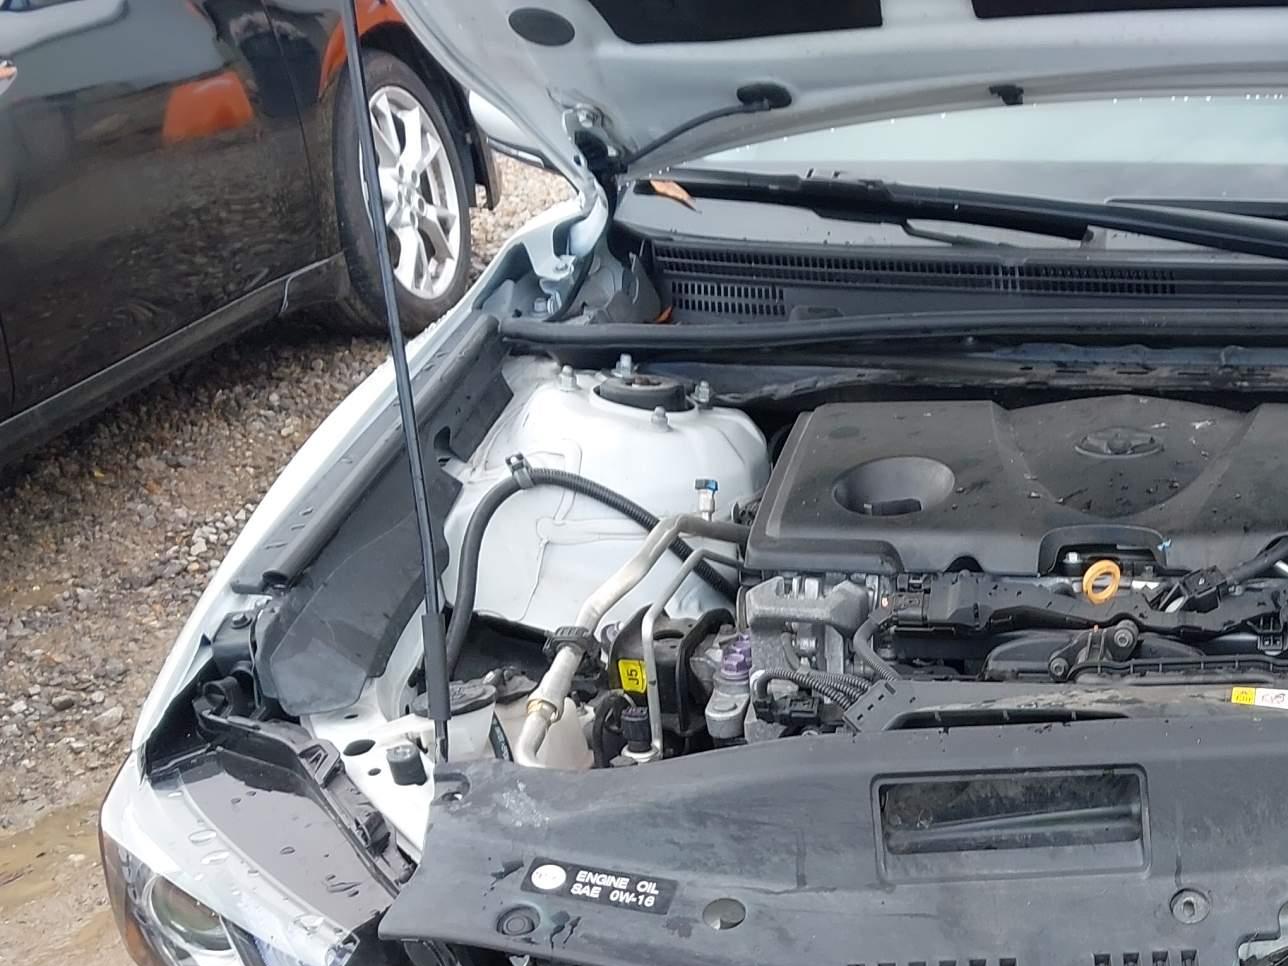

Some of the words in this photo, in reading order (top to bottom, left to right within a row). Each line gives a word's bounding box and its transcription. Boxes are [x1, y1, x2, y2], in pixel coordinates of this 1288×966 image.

[576, 870, 630, 889] ENGINE
[636, 881, 659, 895] OIL
[570, 883, 602, 898] SAE
[609, 890, 655, 907] 0W-16
